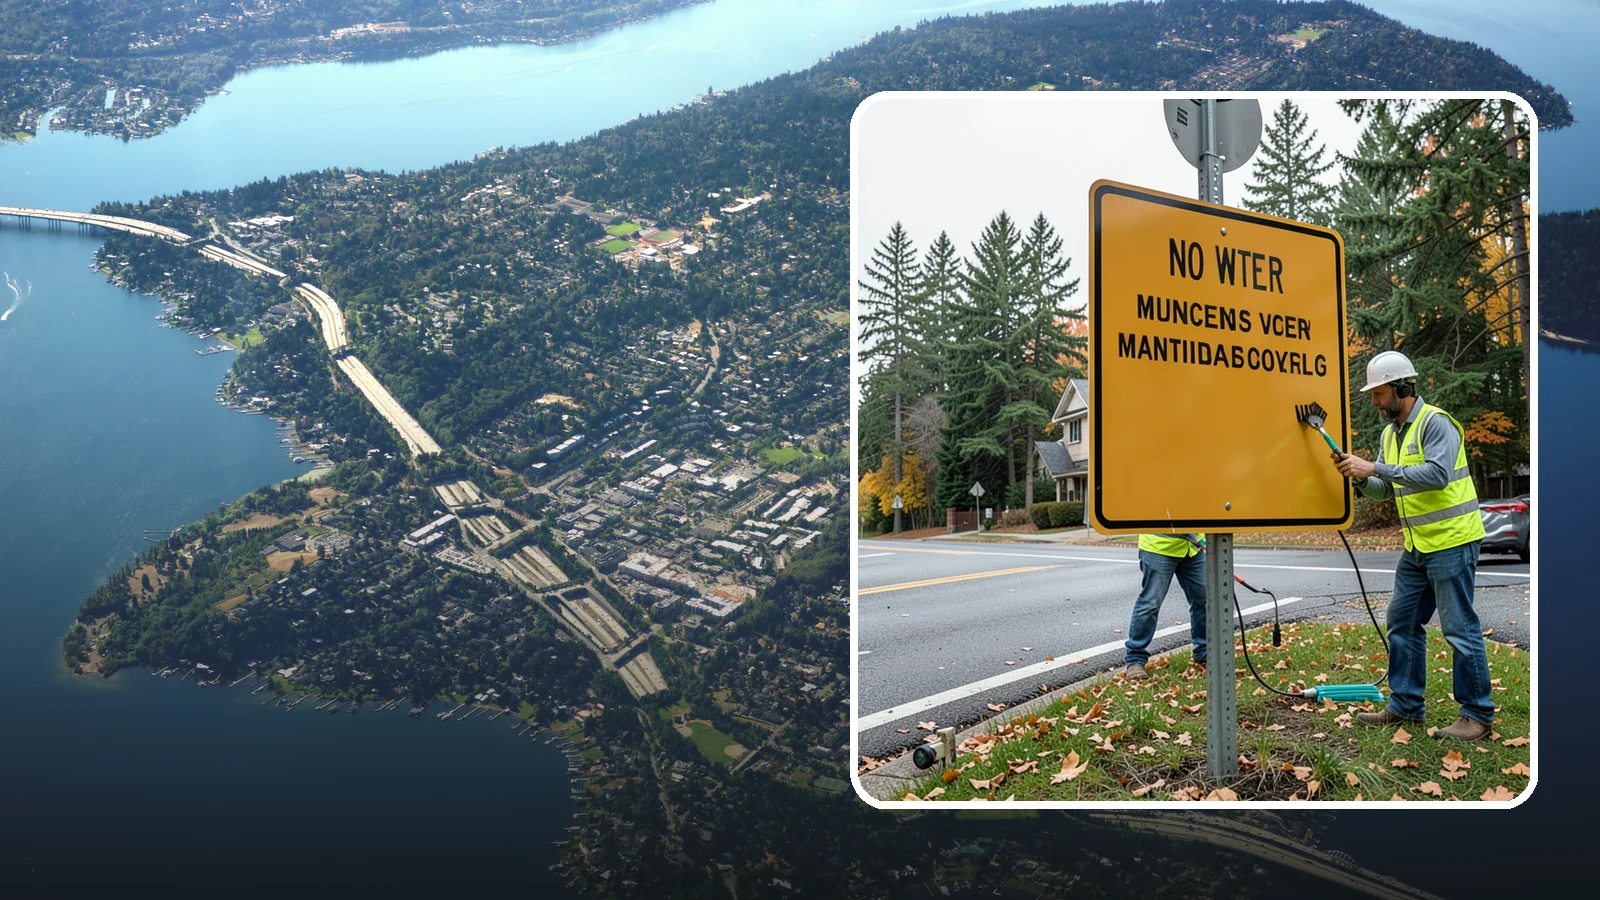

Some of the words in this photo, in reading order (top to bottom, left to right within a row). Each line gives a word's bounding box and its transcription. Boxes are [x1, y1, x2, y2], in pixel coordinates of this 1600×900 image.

[1168, 237, 1205, 281] NO
[1214, 245, 1284, 295] WTER
[1136, 293, 1252, 333] MUNCENS
